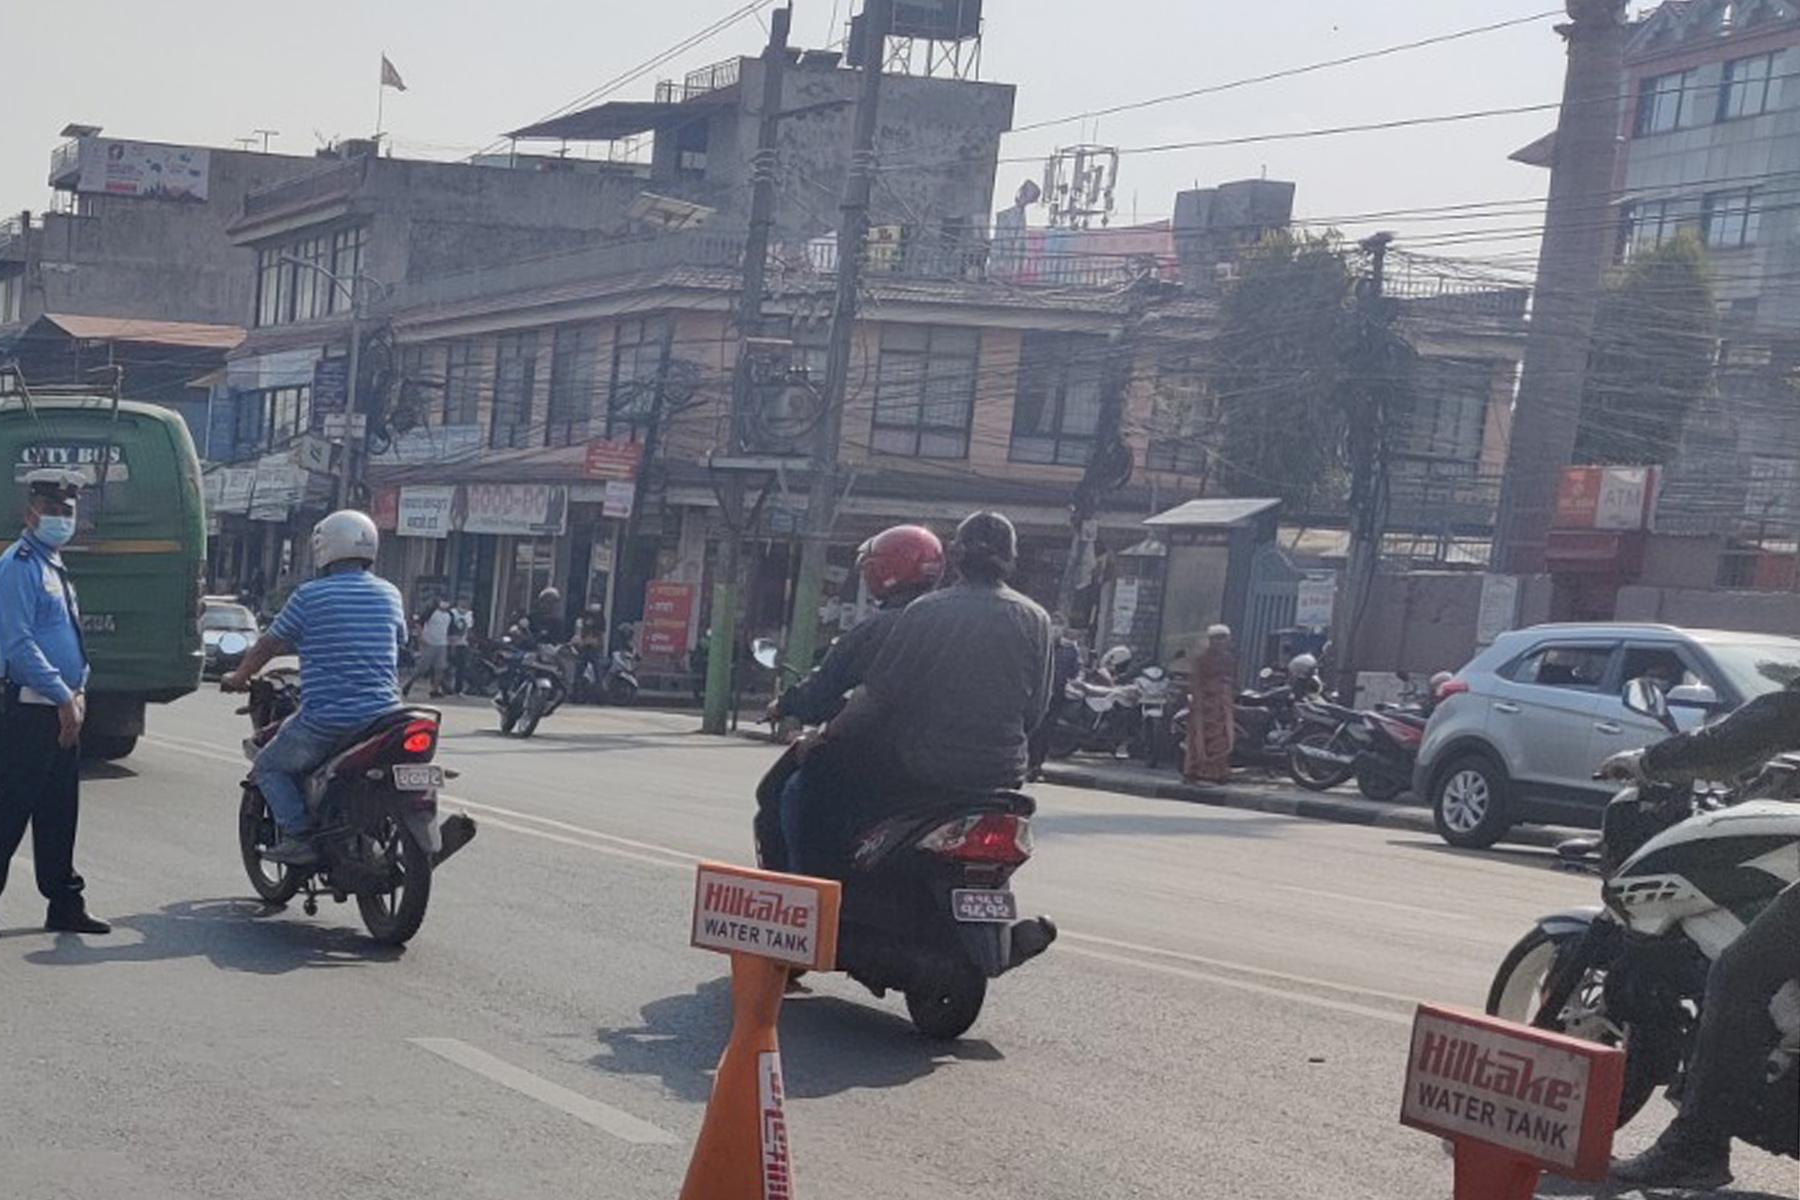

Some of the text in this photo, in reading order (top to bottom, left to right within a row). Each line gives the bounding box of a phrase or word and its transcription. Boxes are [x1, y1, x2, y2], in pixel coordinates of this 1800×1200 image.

[22, 445, 121, 464] CITY BUS
[704, 883, 808, 928] Hilltake
[704, 918, 808, 953] WATER TANK
[1417, 1030, 1573, 1112] Hilltake
[1418, 1082, 1568, 1149] WATER TANK
